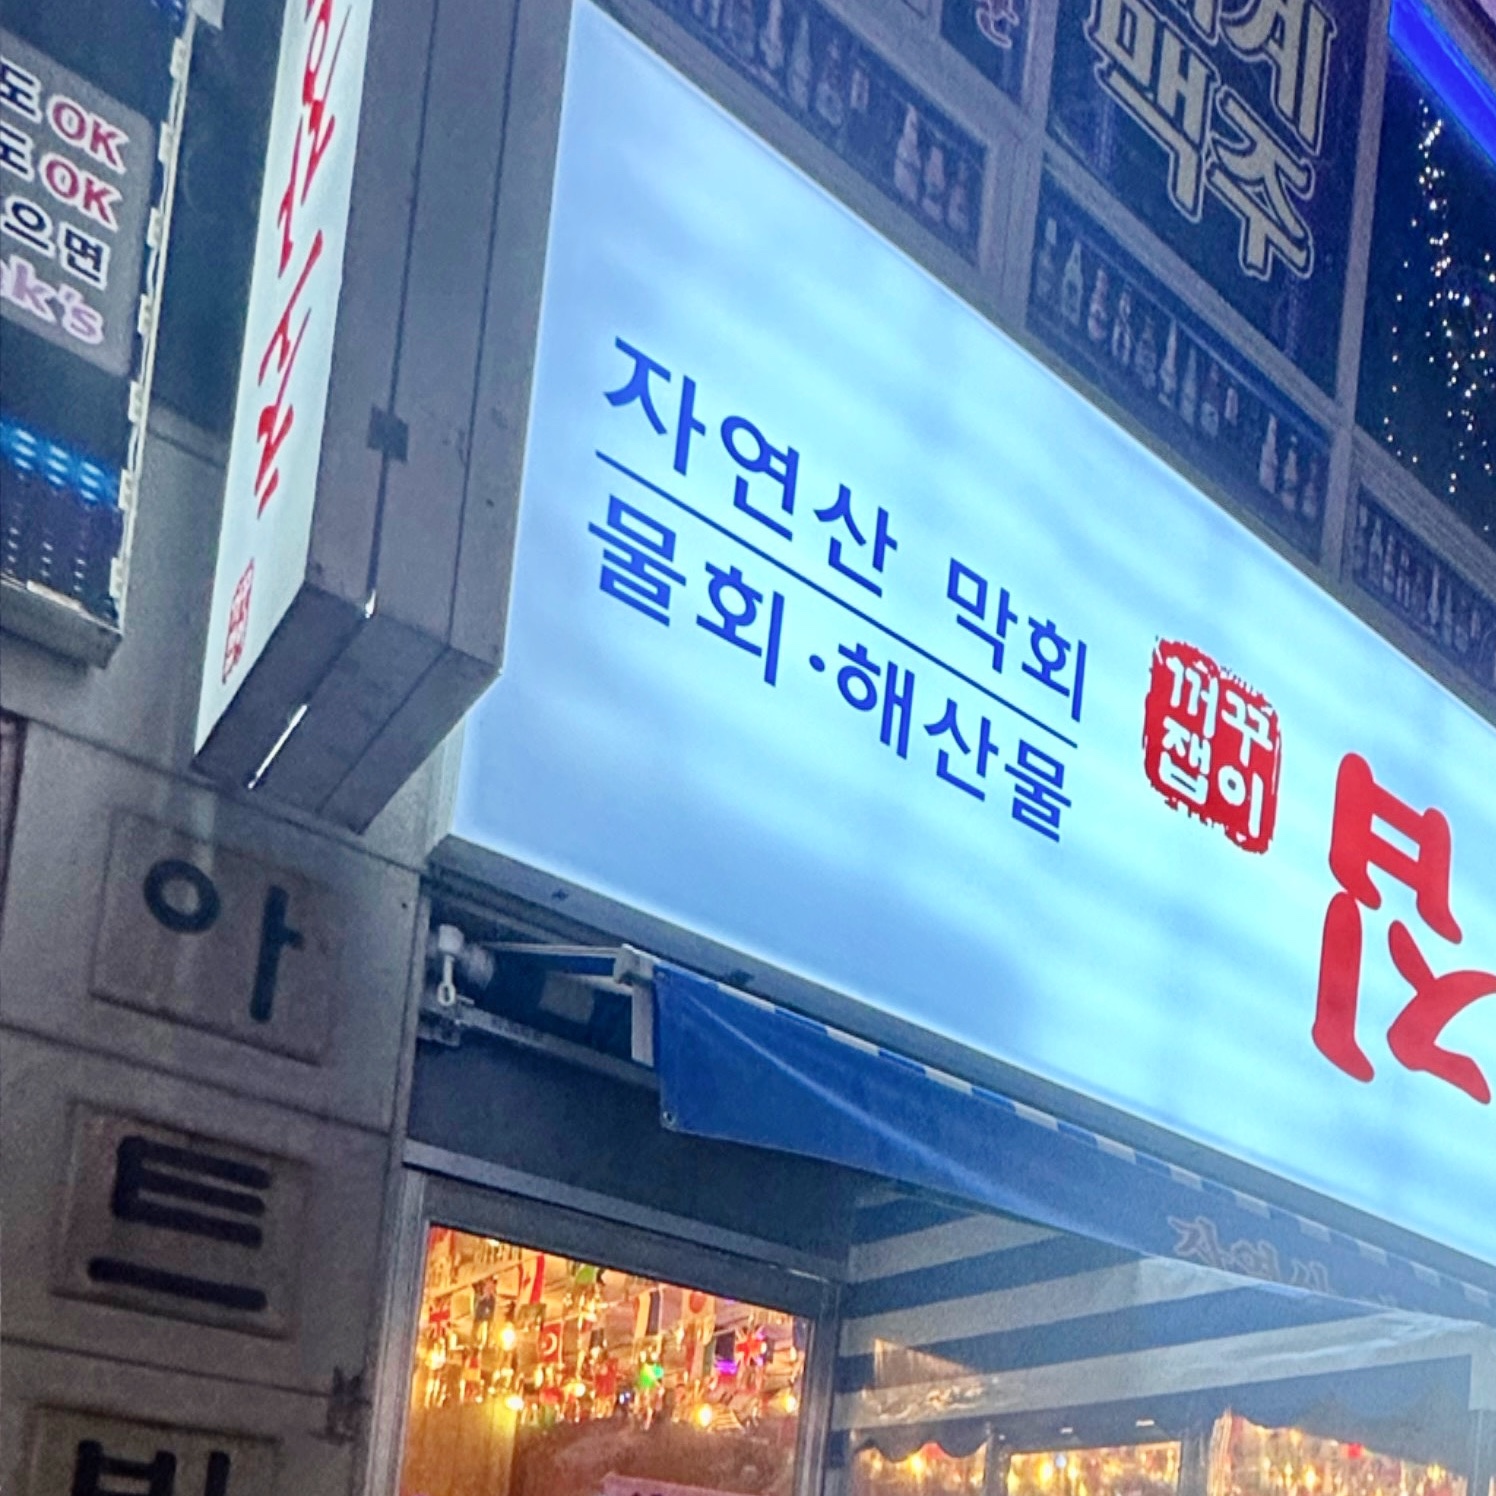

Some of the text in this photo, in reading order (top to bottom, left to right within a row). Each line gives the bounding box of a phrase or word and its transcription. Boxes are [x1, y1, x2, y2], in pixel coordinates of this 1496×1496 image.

[1083, 0, 1315, 282] 맥주
[603, 337, 1088, 721] 자연산 막회
